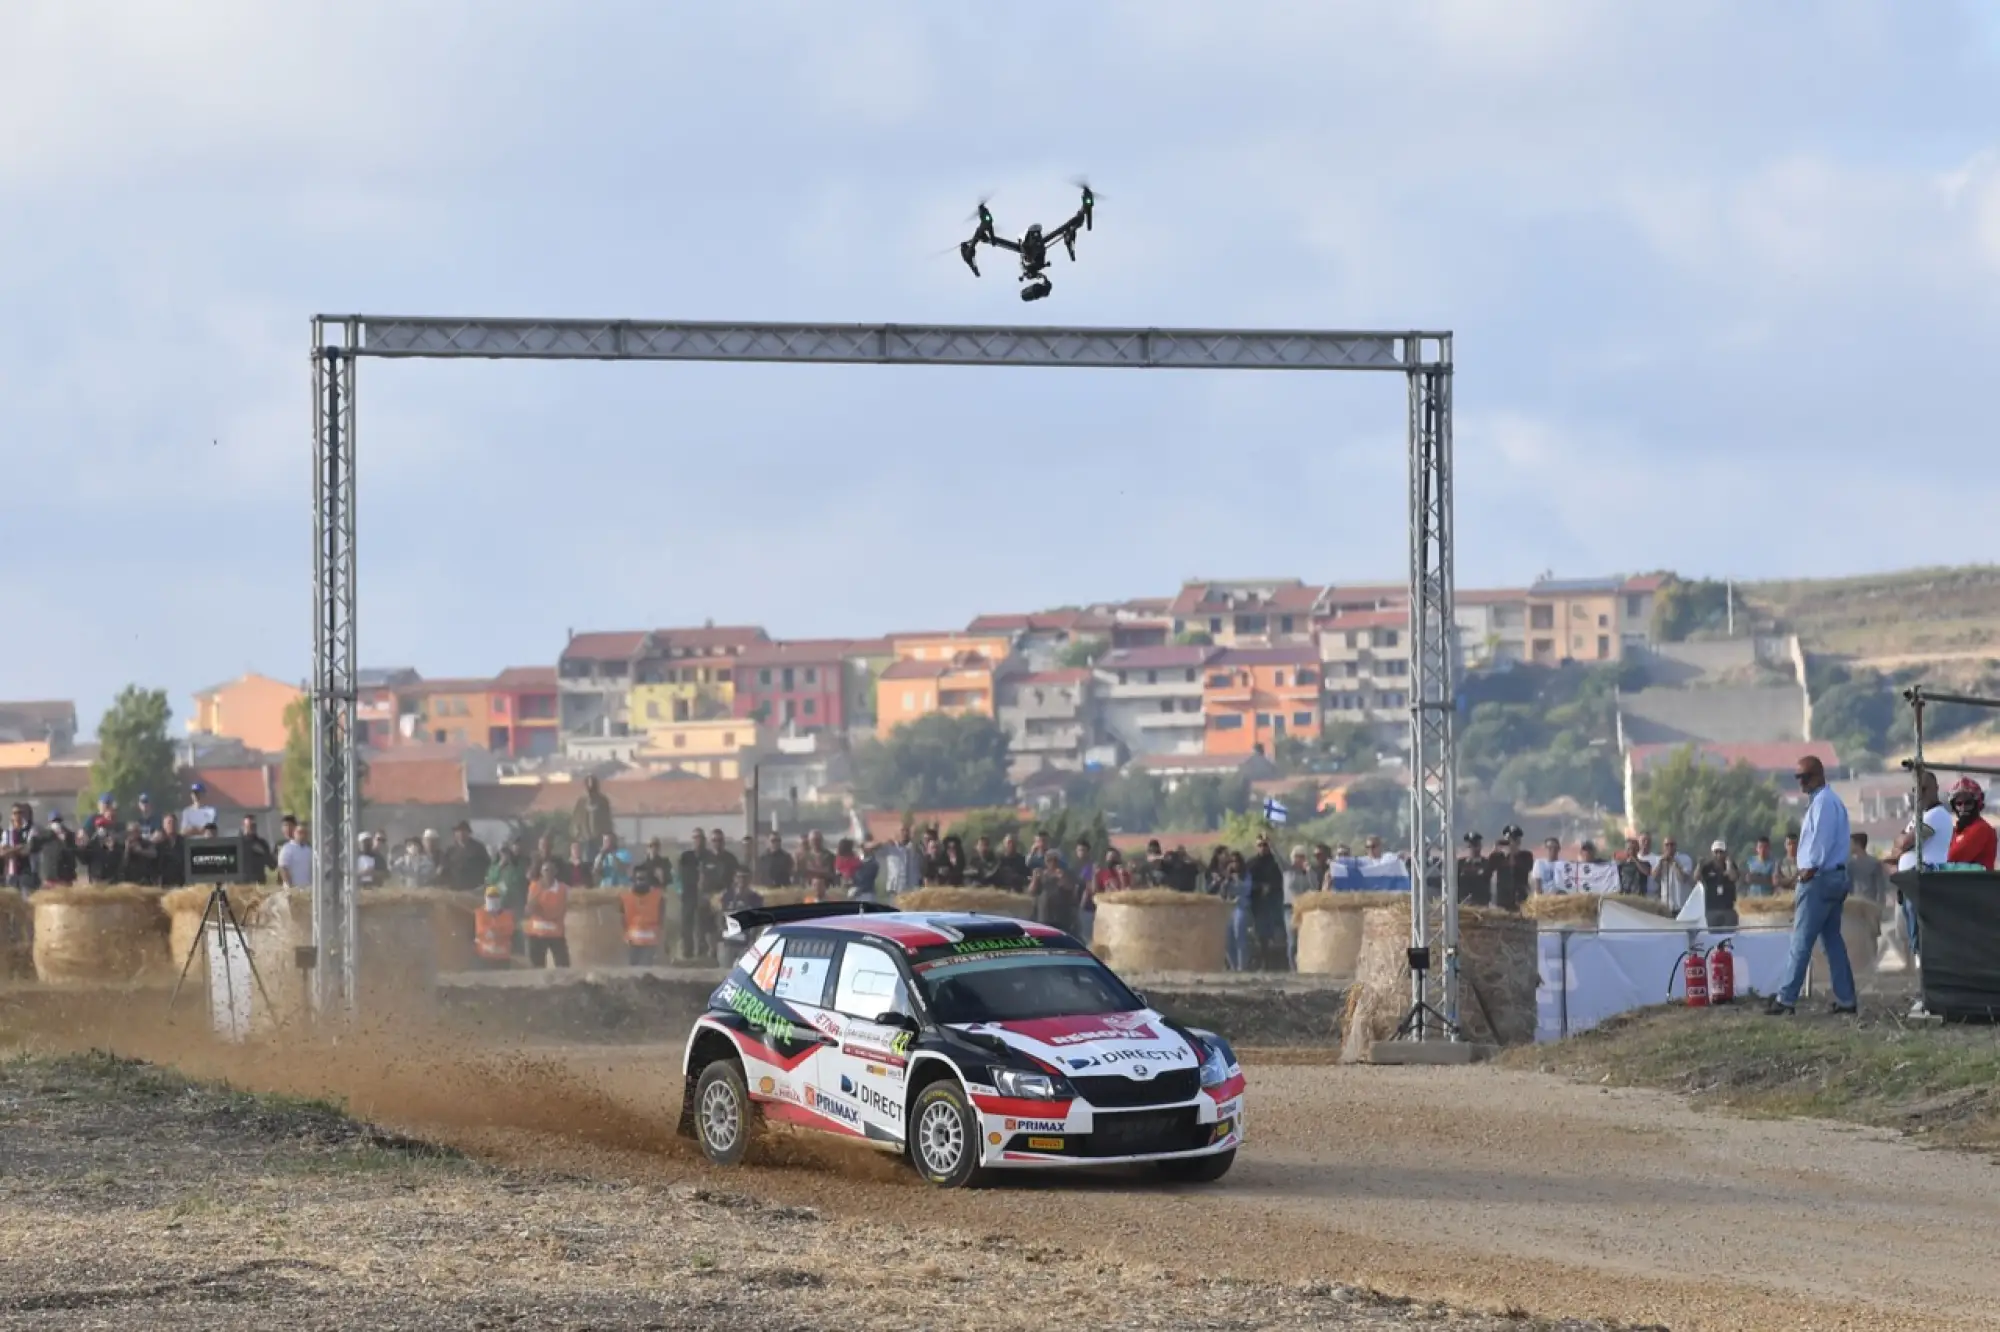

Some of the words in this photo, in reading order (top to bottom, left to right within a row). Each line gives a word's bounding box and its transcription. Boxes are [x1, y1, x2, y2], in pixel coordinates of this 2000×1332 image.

[952, 936, 1044, 954] HERBALIFE
[730, 986, 794, 1046] HERBALIFE
[1102, 1047, 1183, 1063] DIRECTV
[816, 1092, 859, 1125] PRIMAX
[861, 1084, 903, 1122] DIRECT
[1017, 1120, 1066, 1132] PRIMAX
